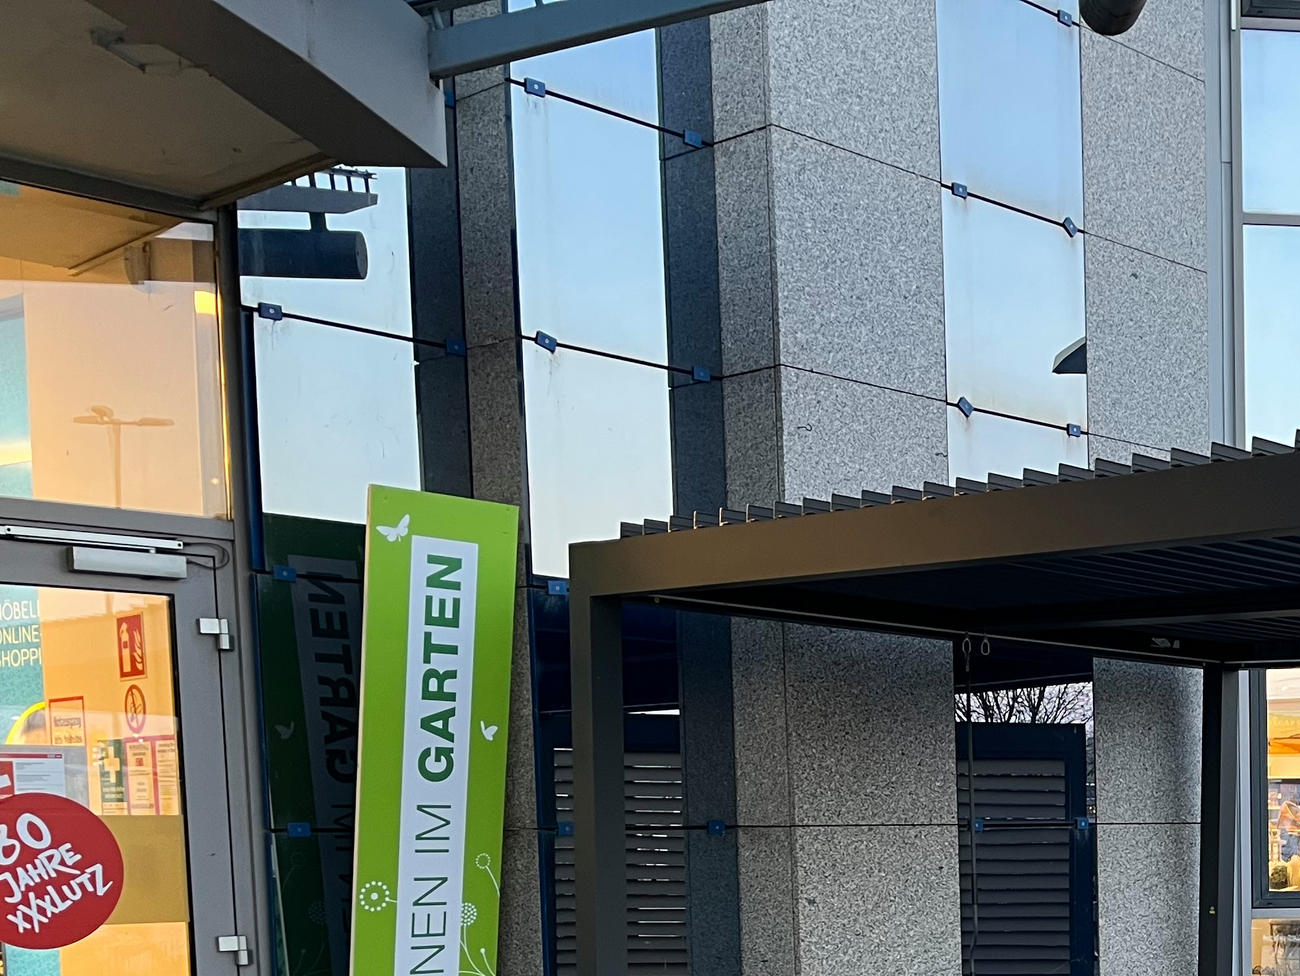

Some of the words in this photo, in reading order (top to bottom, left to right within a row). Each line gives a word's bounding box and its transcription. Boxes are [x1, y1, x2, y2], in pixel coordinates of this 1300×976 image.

[417, 553, 463, 783] GARTEN
[414, 803, 452, 854] IM
[0, 842, 82, 903] JAHRE
